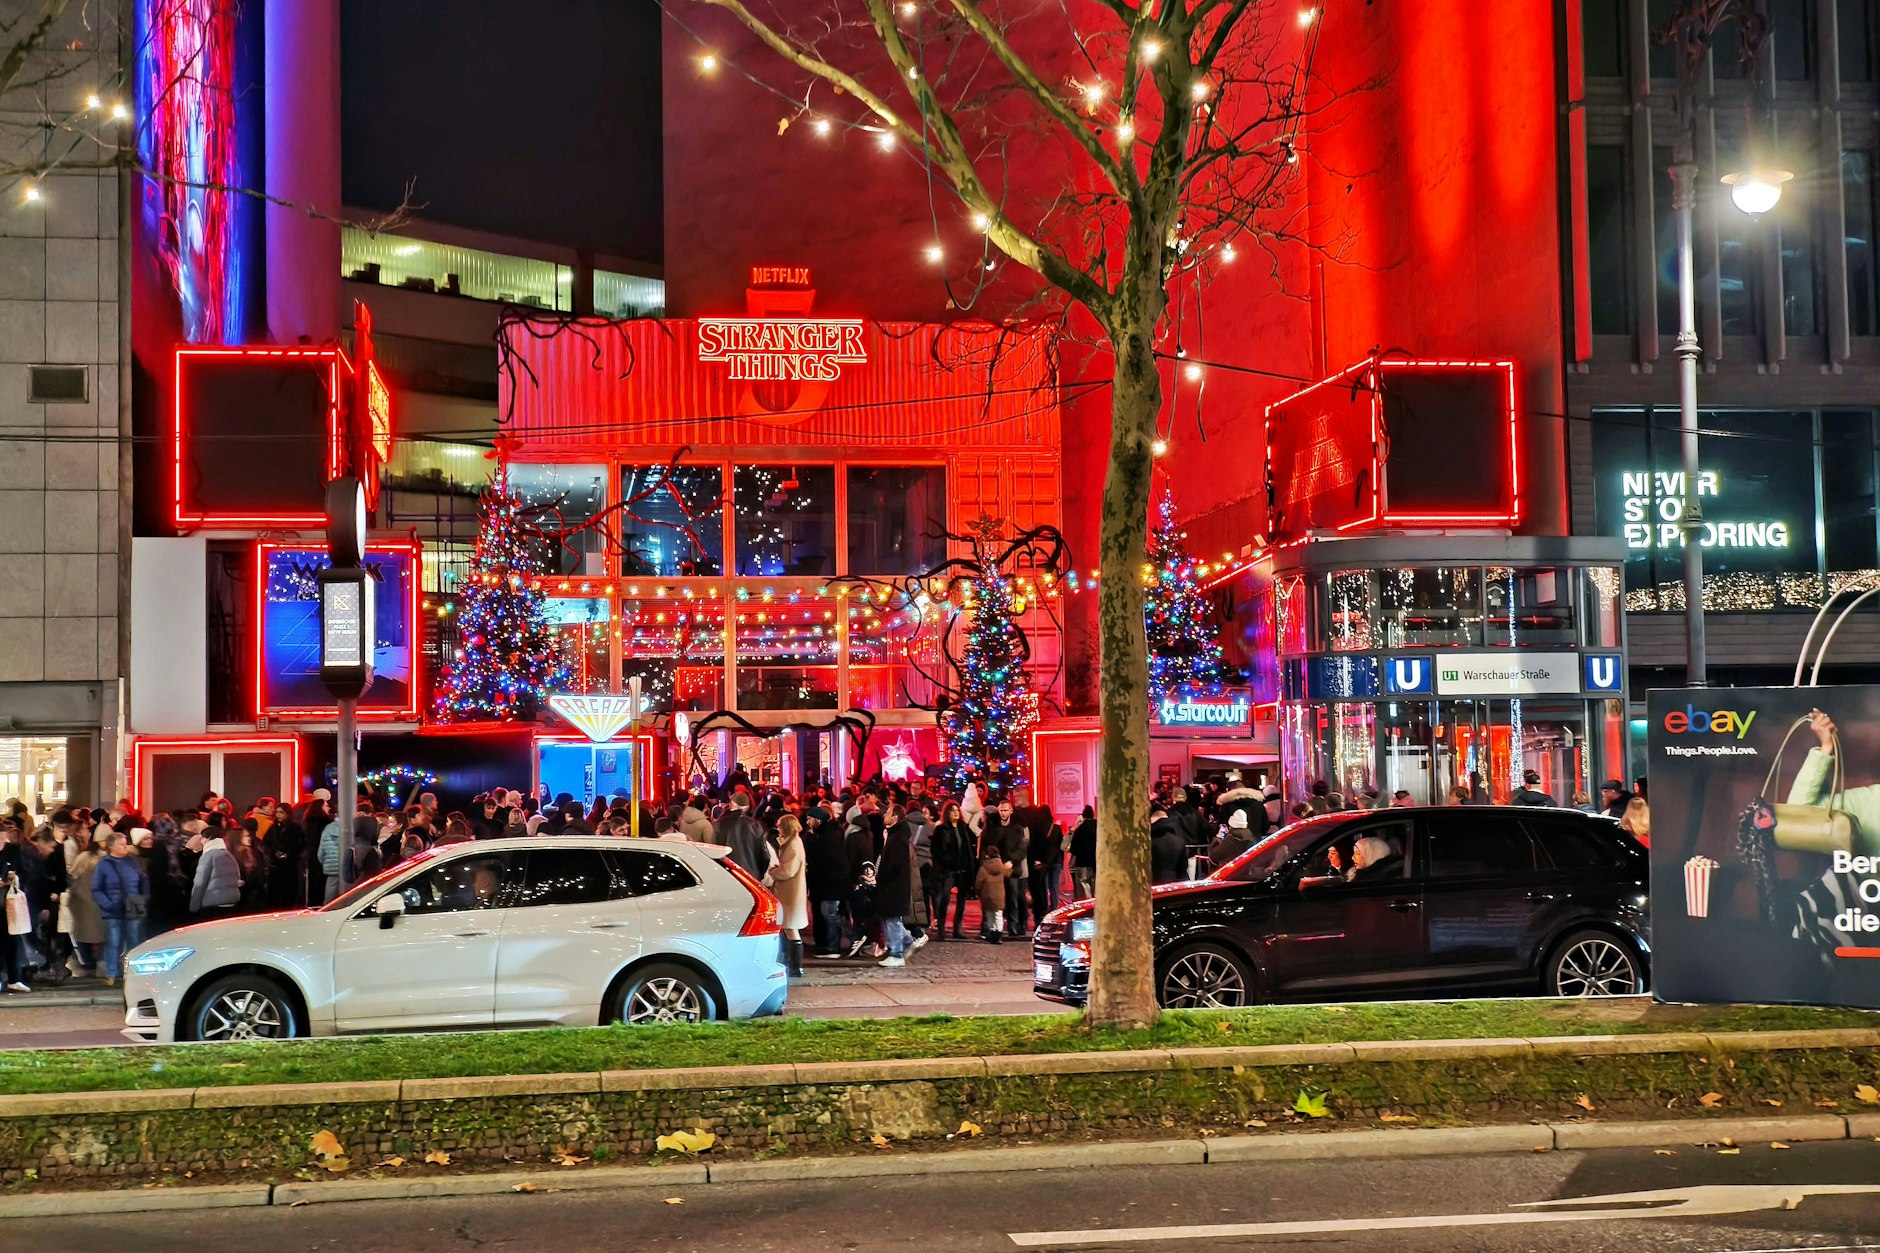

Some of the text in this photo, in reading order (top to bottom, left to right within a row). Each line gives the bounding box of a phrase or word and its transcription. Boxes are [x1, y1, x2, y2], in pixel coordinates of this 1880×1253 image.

[753, 267, 809, 285] NETFLIX
[699, 322, 867, 357] STRANGER
[725, 353, 841, 381] THINGS
[1623, 472, 1718, 496] NEVR
[1395, 659, 1421, 690] U
[1443, 669, 1550, 680] U1 Warschauer Straße
[1592, 657, 1614, 688] U
[552, 698, 646, 714] ARCAD
[1175, 695, 1248, 723] starcourt
[1664, 703, 1757, 740] ebay
[1833, 907, 1880, 932] die
